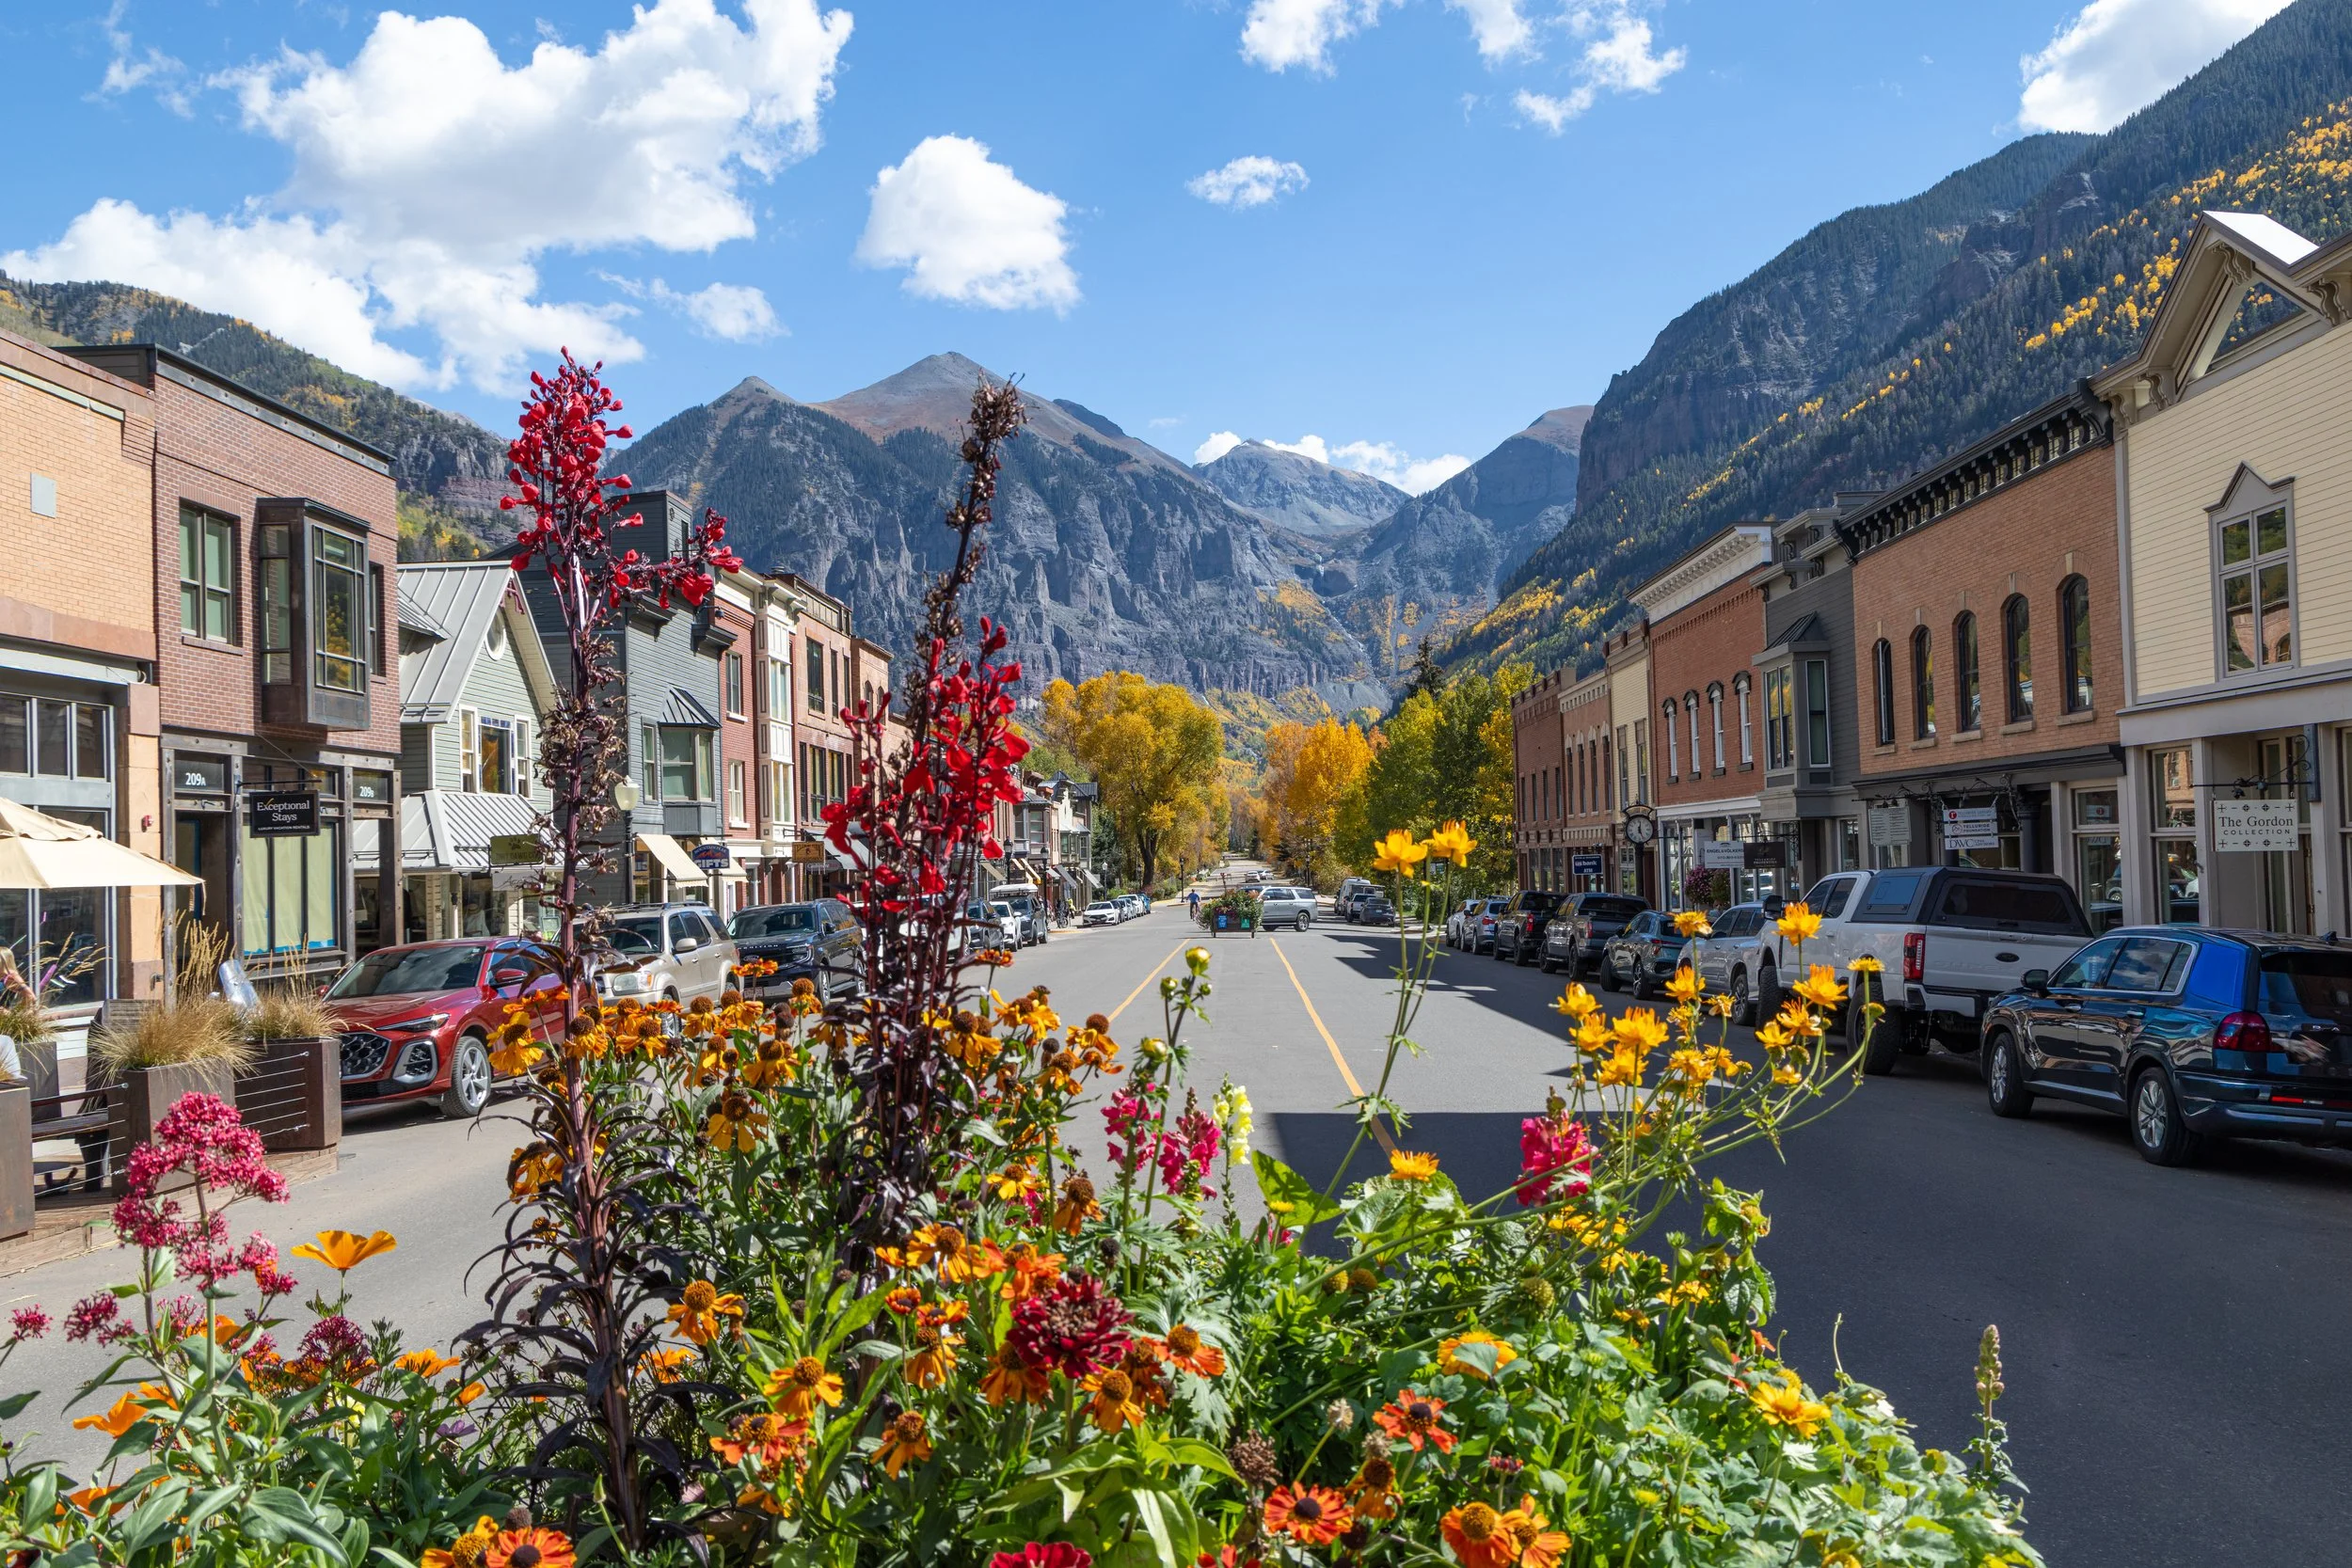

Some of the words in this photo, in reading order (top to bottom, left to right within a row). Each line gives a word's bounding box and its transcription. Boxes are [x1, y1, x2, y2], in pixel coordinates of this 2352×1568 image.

[185, 772, 206, 786] 209A
[257, 800, 310, 812] Exceptional
[272, 812, 297, 823] Stays
[2218, 816, 2242, 827] The
[2247, 816, 2293, 827] Gordon
[1949, 839, 1974, 847] DWC
[693, 859, 728, 868] GIFTS
